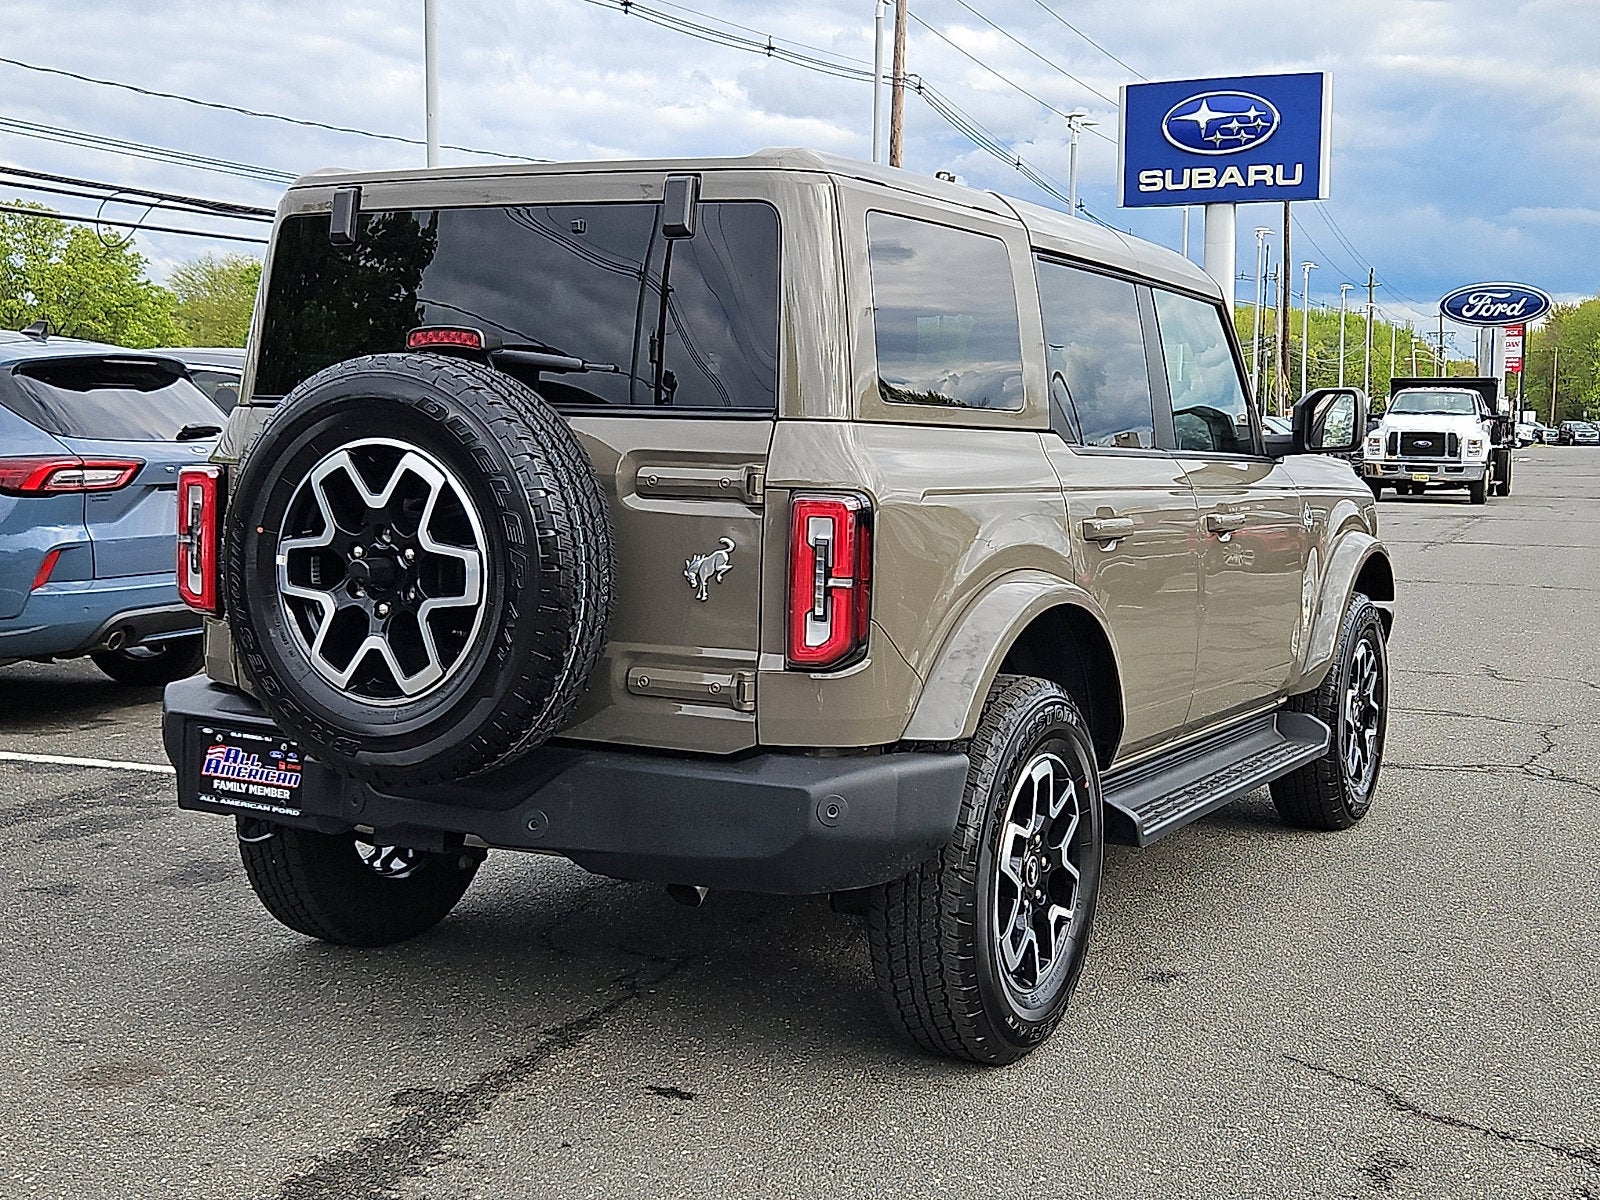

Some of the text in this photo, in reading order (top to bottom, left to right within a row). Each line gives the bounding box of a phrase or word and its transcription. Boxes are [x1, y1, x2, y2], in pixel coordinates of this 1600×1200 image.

[1138, 163, 1303, 192] SUBARU
[1461, 291, 1528, 318] Ford
[411, 395, 531, 591] DUELER
[212, 779, 291, 800] FAMILY MEMBER
[199, 794, 300, 816] ALL AMERICAN FORD
